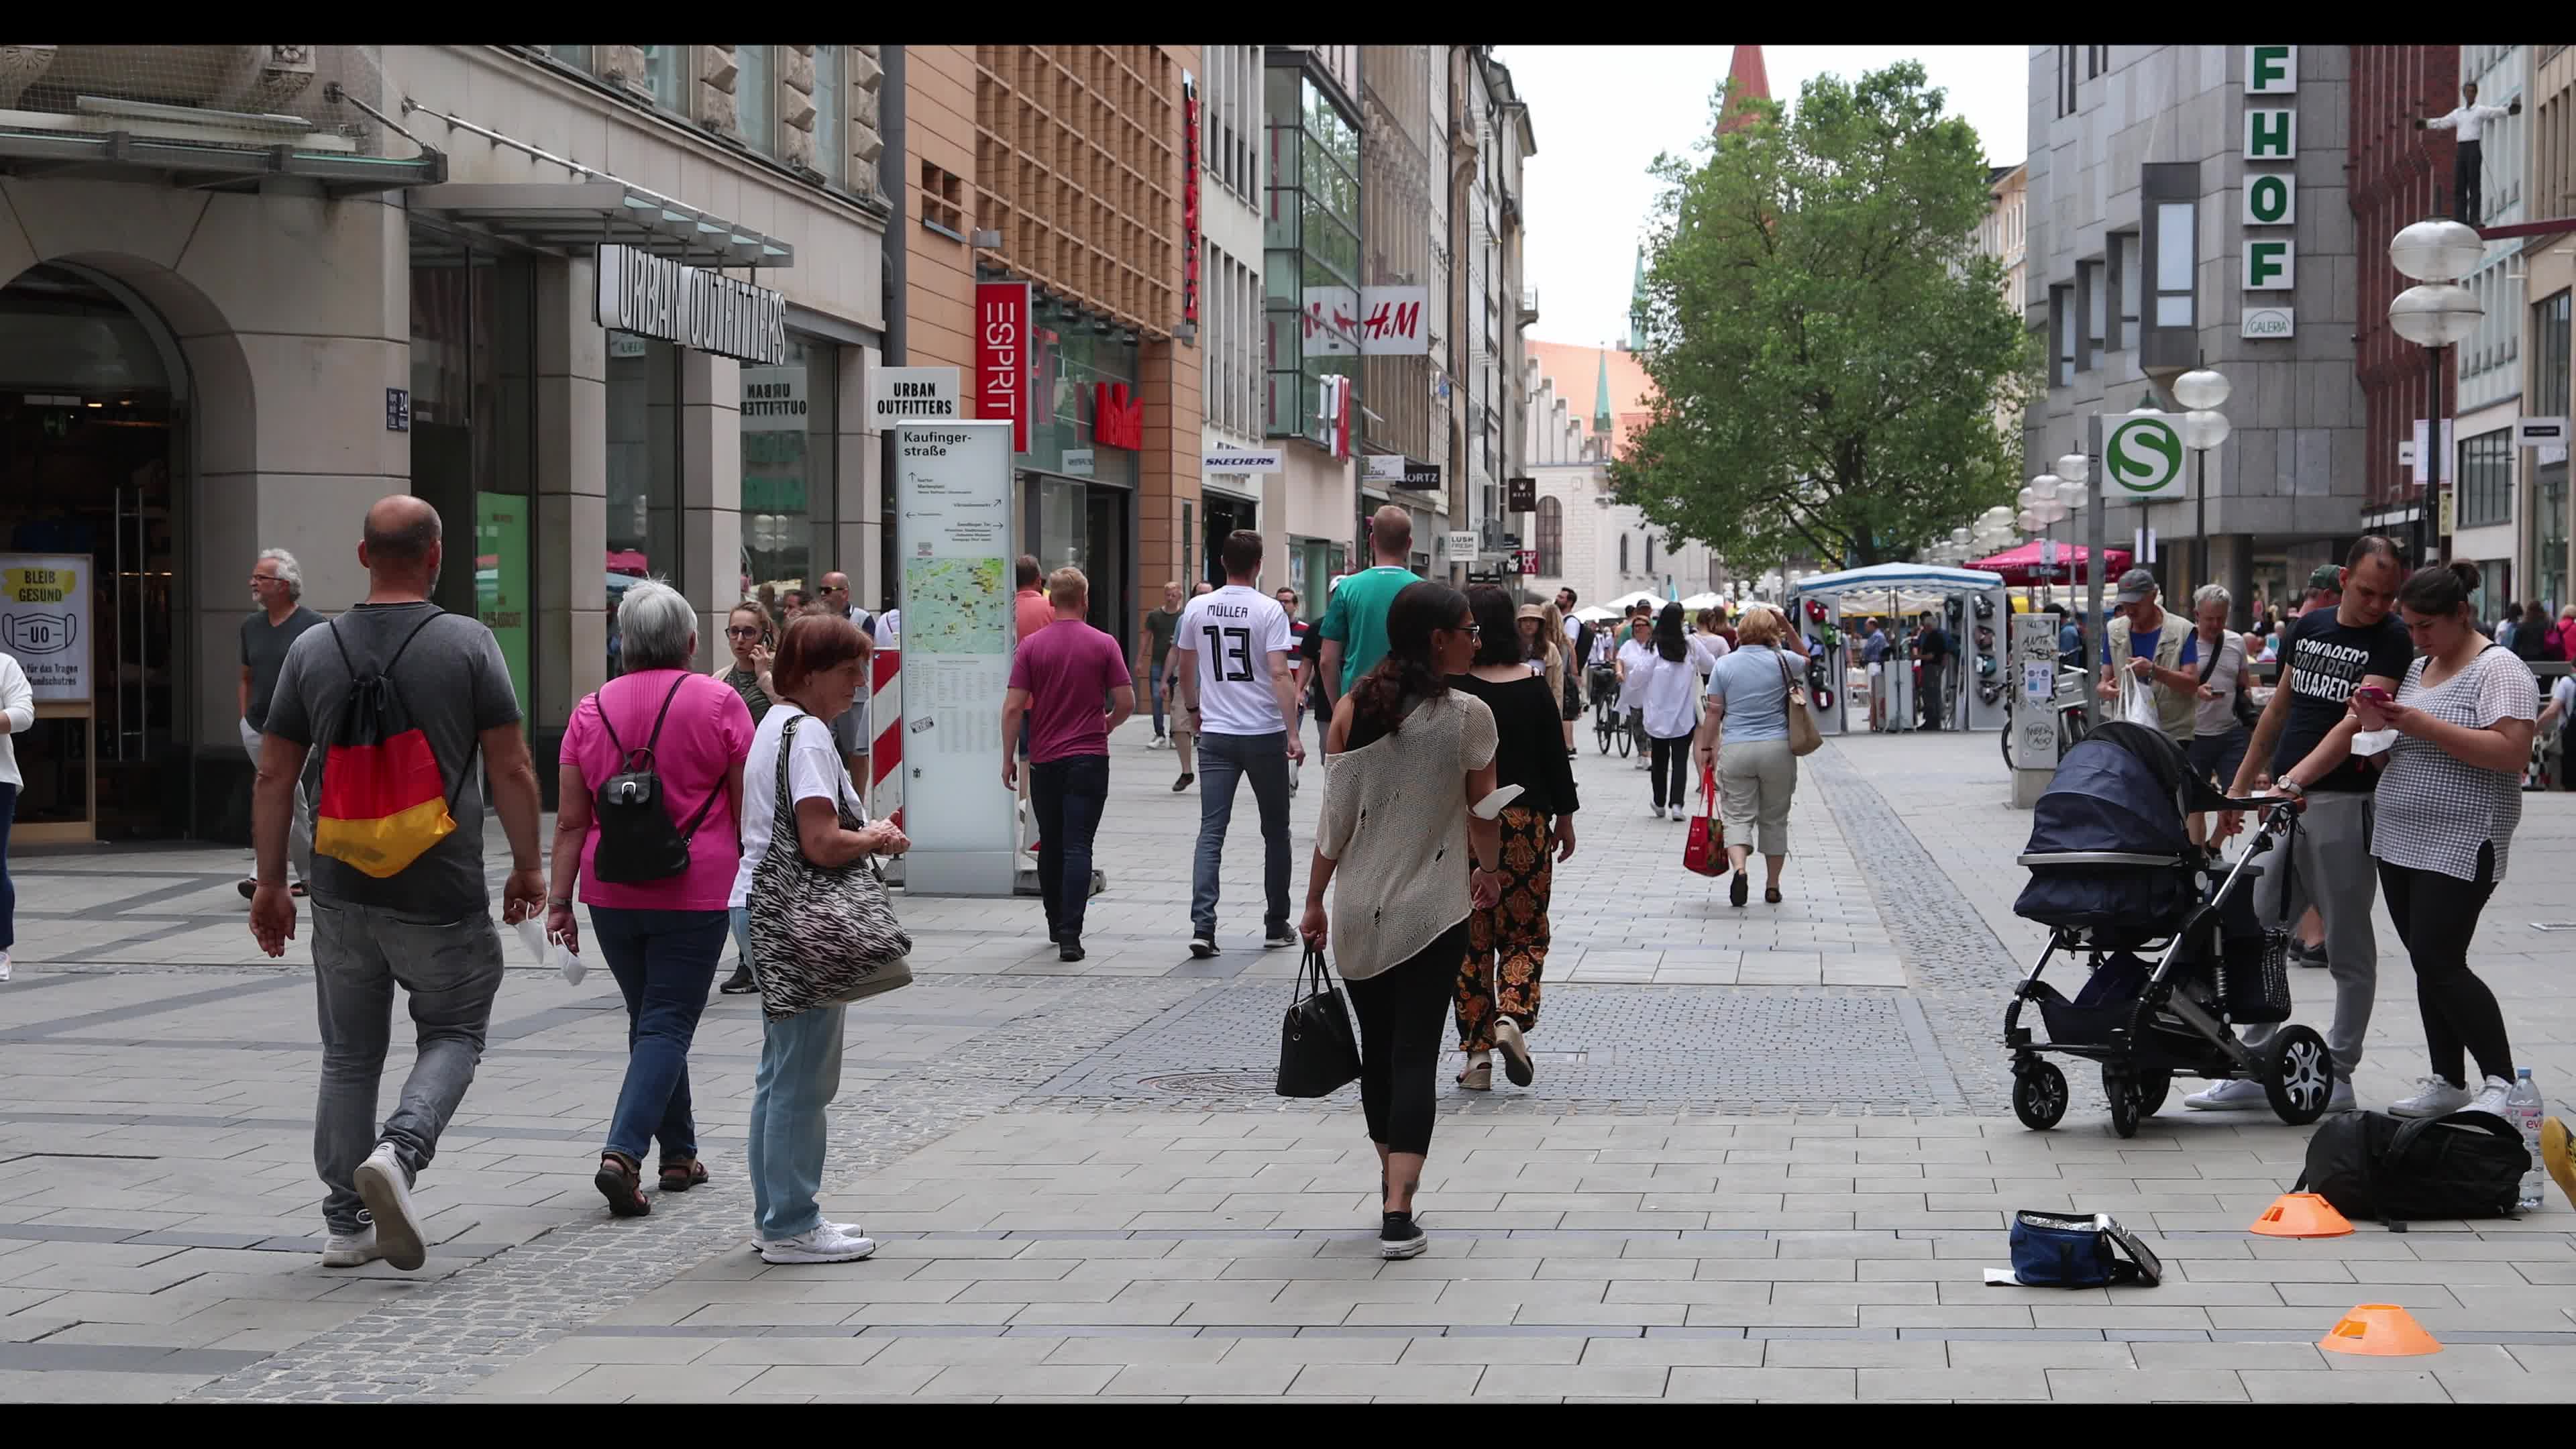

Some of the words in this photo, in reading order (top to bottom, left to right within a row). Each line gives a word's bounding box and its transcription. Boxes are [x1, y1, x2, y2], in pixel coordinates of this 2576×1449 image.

[620, 244, 682, 340] URBAN
[690, 267, 786, 366] OUTFITTERS
[1363, 301, 1419, 339] H&M
[2250, 322, 2287, 333] GALERIA
[986, 303, 1015, 415] ESPRIT
[894, 383, 936, 396] URBAN
[877, 400, 952, 414] OUTFITTERS
[904, 431, 971, 445] Kaufinger-
[904, 445, 947, 456] straße
[25, 571, 55, 584] BLEIB
[19, 589, 62, 602] GESUND
[1208, 603, 1248, 618] MÜLLER
[31, 627, 49, 643] UO
[1203, 625, 1254, 682] 13
[27, 664, 38, 674] für
[40, 664, 52, 673] das
